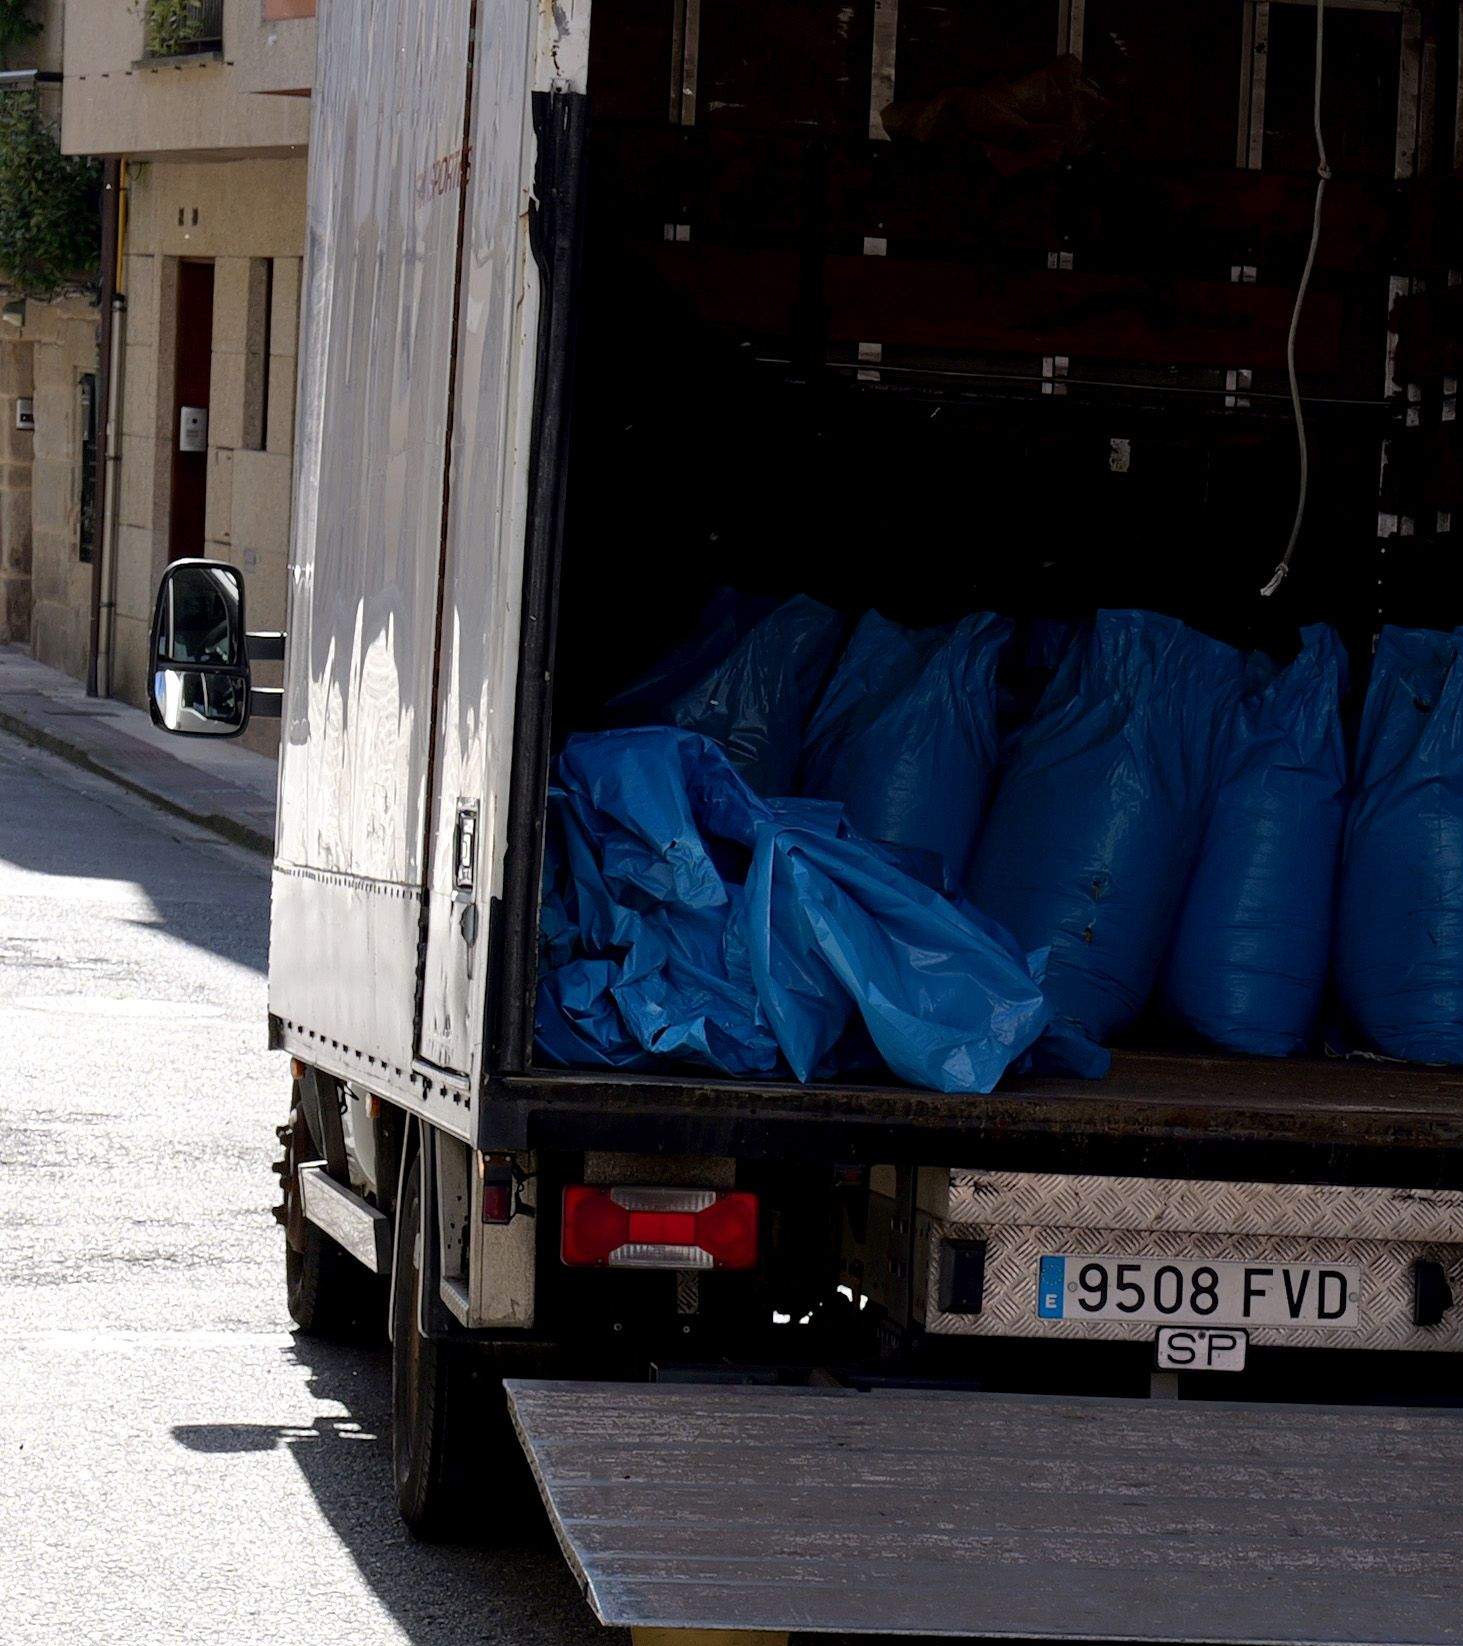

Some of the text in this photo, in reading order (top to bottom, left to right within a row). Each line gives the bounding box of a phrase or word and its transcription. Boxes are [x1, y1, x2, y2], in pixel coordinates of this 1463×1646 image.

[1045, 1262, 1348, 1319] E 9508 FVD
[1167, 1332, 1237, 1366] SP
